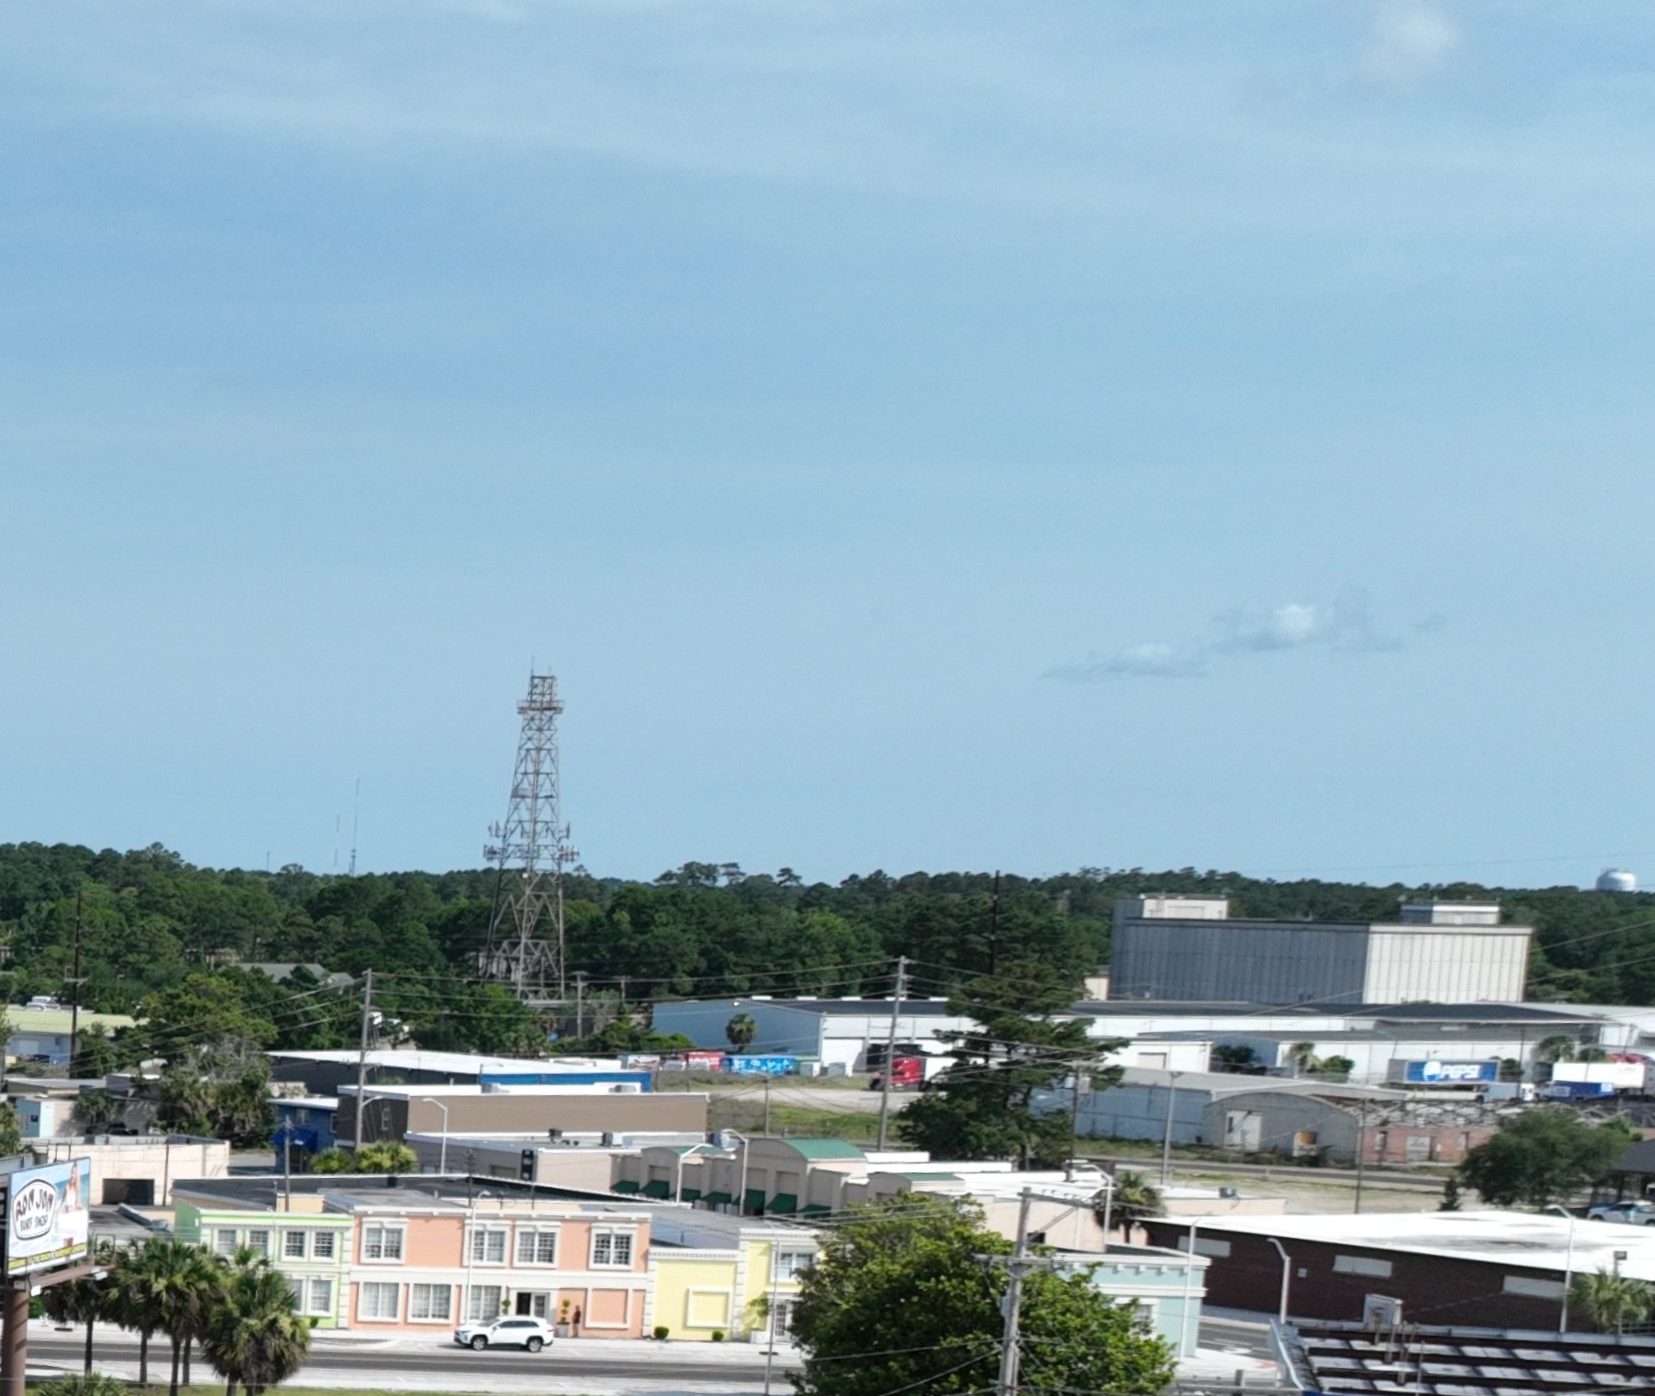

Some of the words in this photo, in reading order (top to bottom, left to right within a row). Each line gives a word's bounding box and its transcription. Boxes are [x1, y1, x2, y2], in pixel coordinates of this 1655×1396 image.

[1440, 1064, 1481, 1079] PEPSI
[16, 1188, 35, 1221] RON
[36, 1188, 54, 1212] JON
[20, 1217, 33, 1232] SURF
[34, 1214, 48, 1229] SHOP
